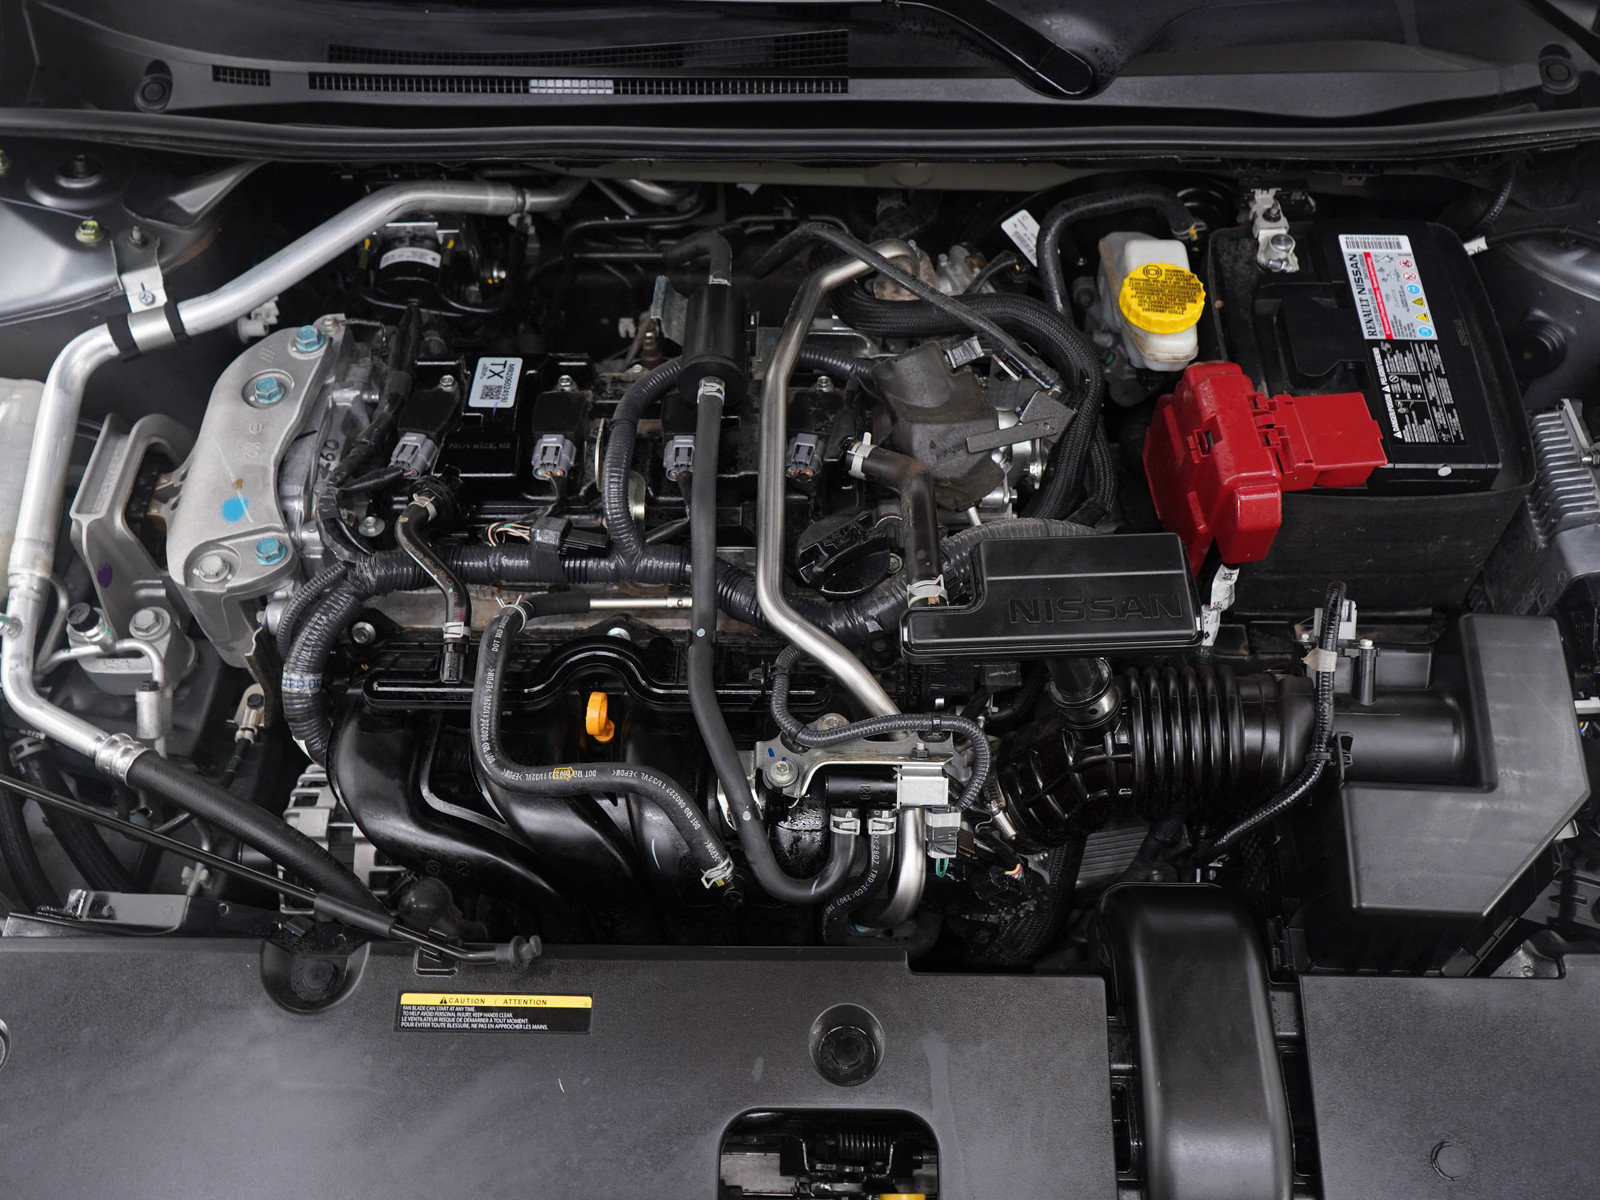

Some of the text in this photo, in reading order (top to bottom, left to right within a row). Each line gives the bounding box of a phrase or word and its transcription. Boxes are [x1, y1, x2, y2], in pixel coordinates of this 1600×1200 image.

[1348, 254, 1366, 295] NISSAN
[1360, 297, 1378, 336] RENAULT
[487, 360, 507, 379] TX
[1008, 593, 1182, 624] NISSAN
